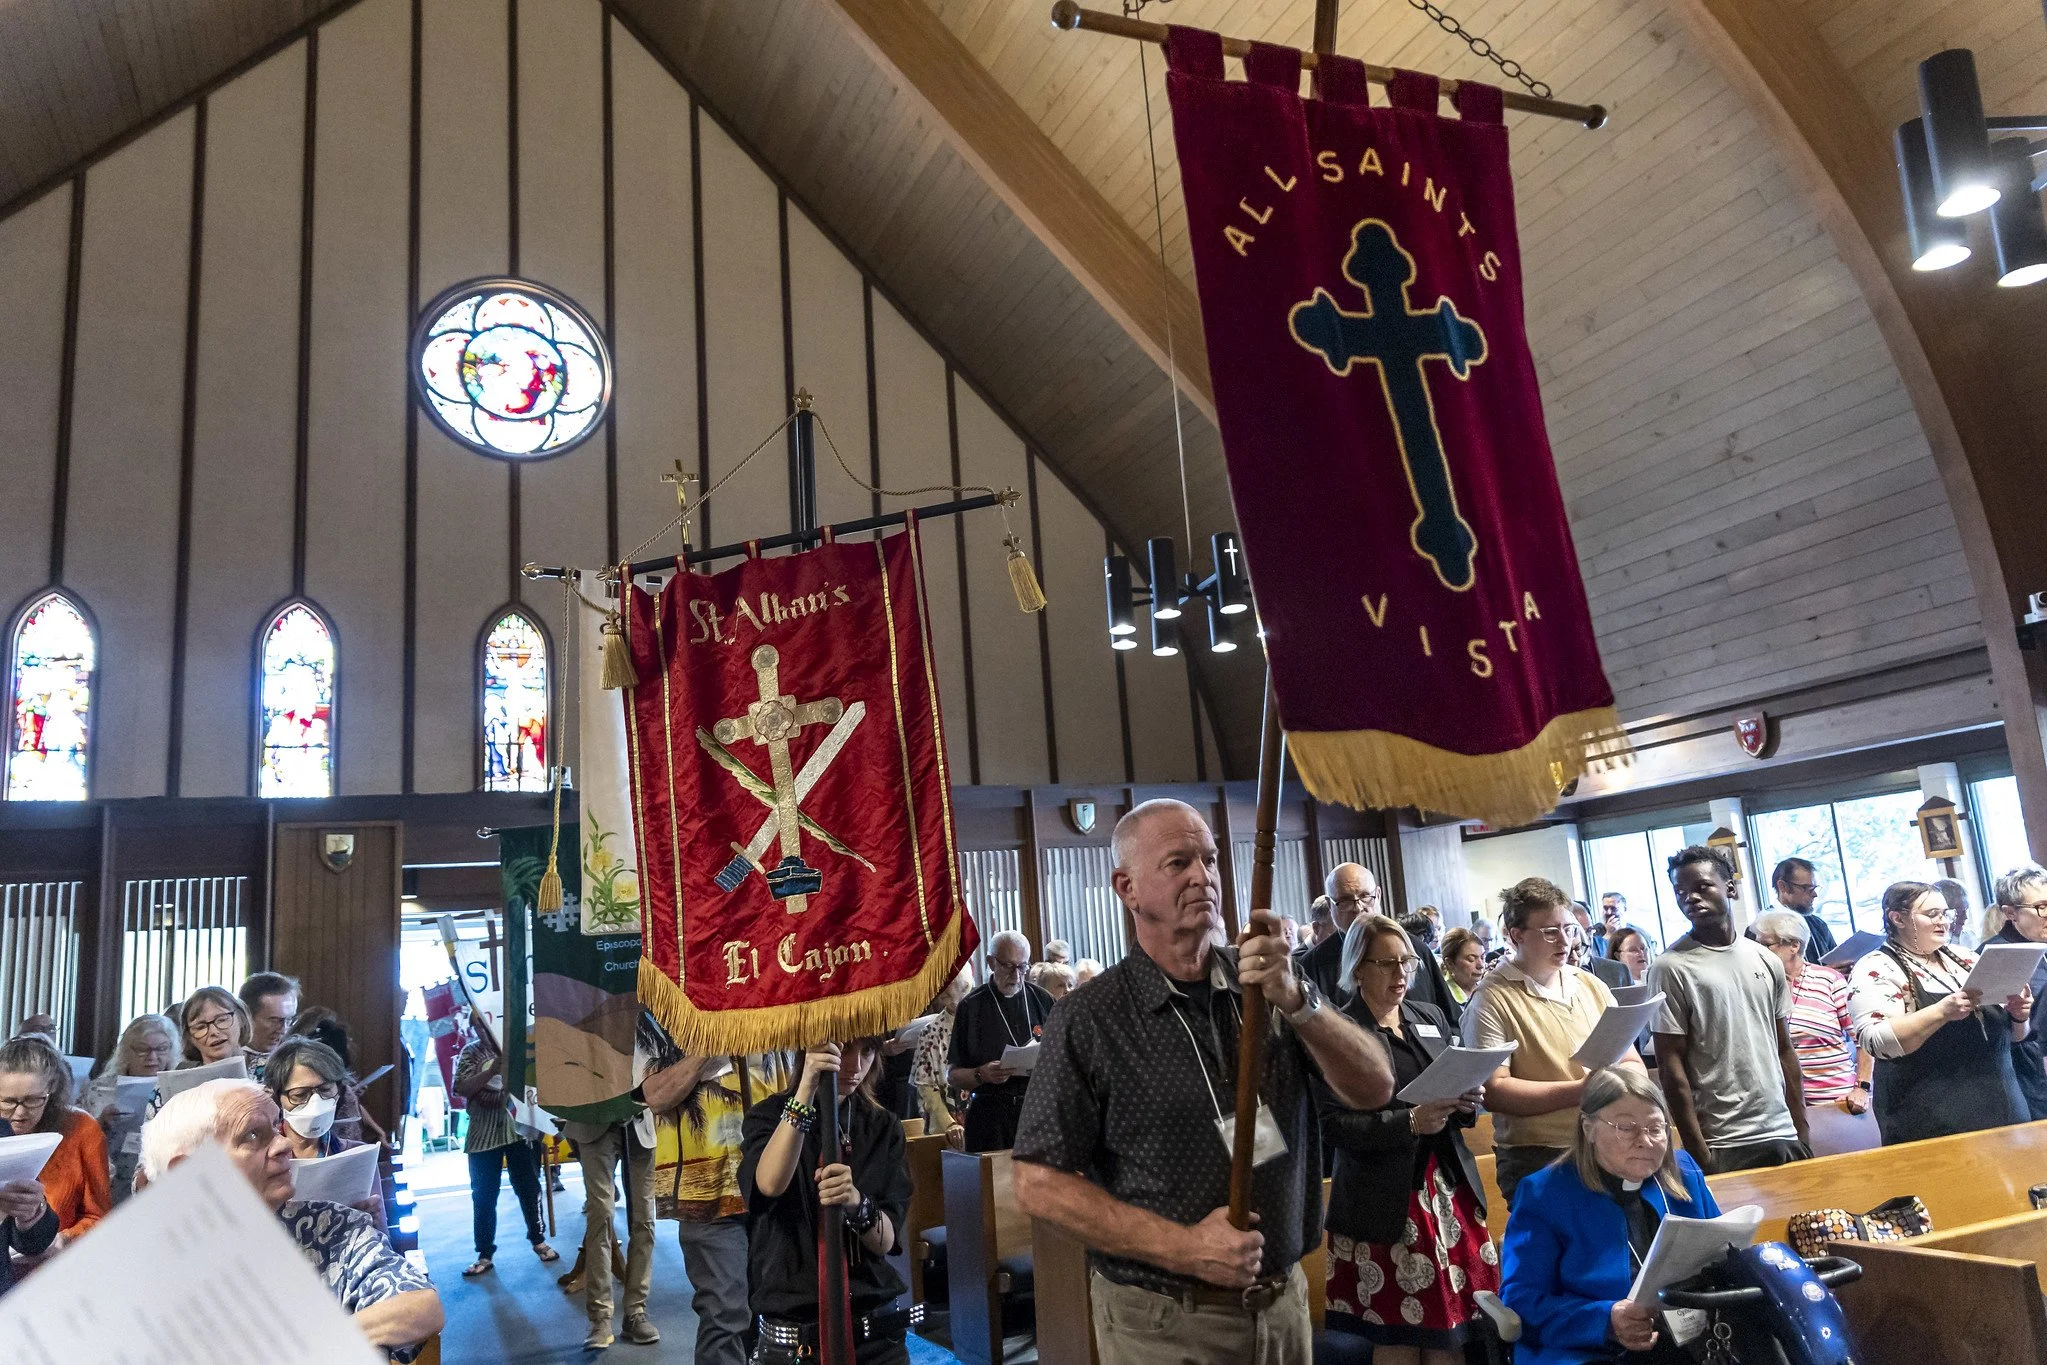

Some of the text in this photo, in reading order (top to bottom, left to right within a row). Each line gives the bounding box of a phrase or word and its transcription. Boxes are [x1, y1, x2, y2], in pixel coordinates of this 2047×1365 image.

[1223, 147, 1501, 283] ALL SAINTS
[727, 581, 851, 645] Alban's
[1361, 590, 1540, 679] VISTA
[596, 938, 642, 952] Episcopa
[722, 940, 761, 990] El
